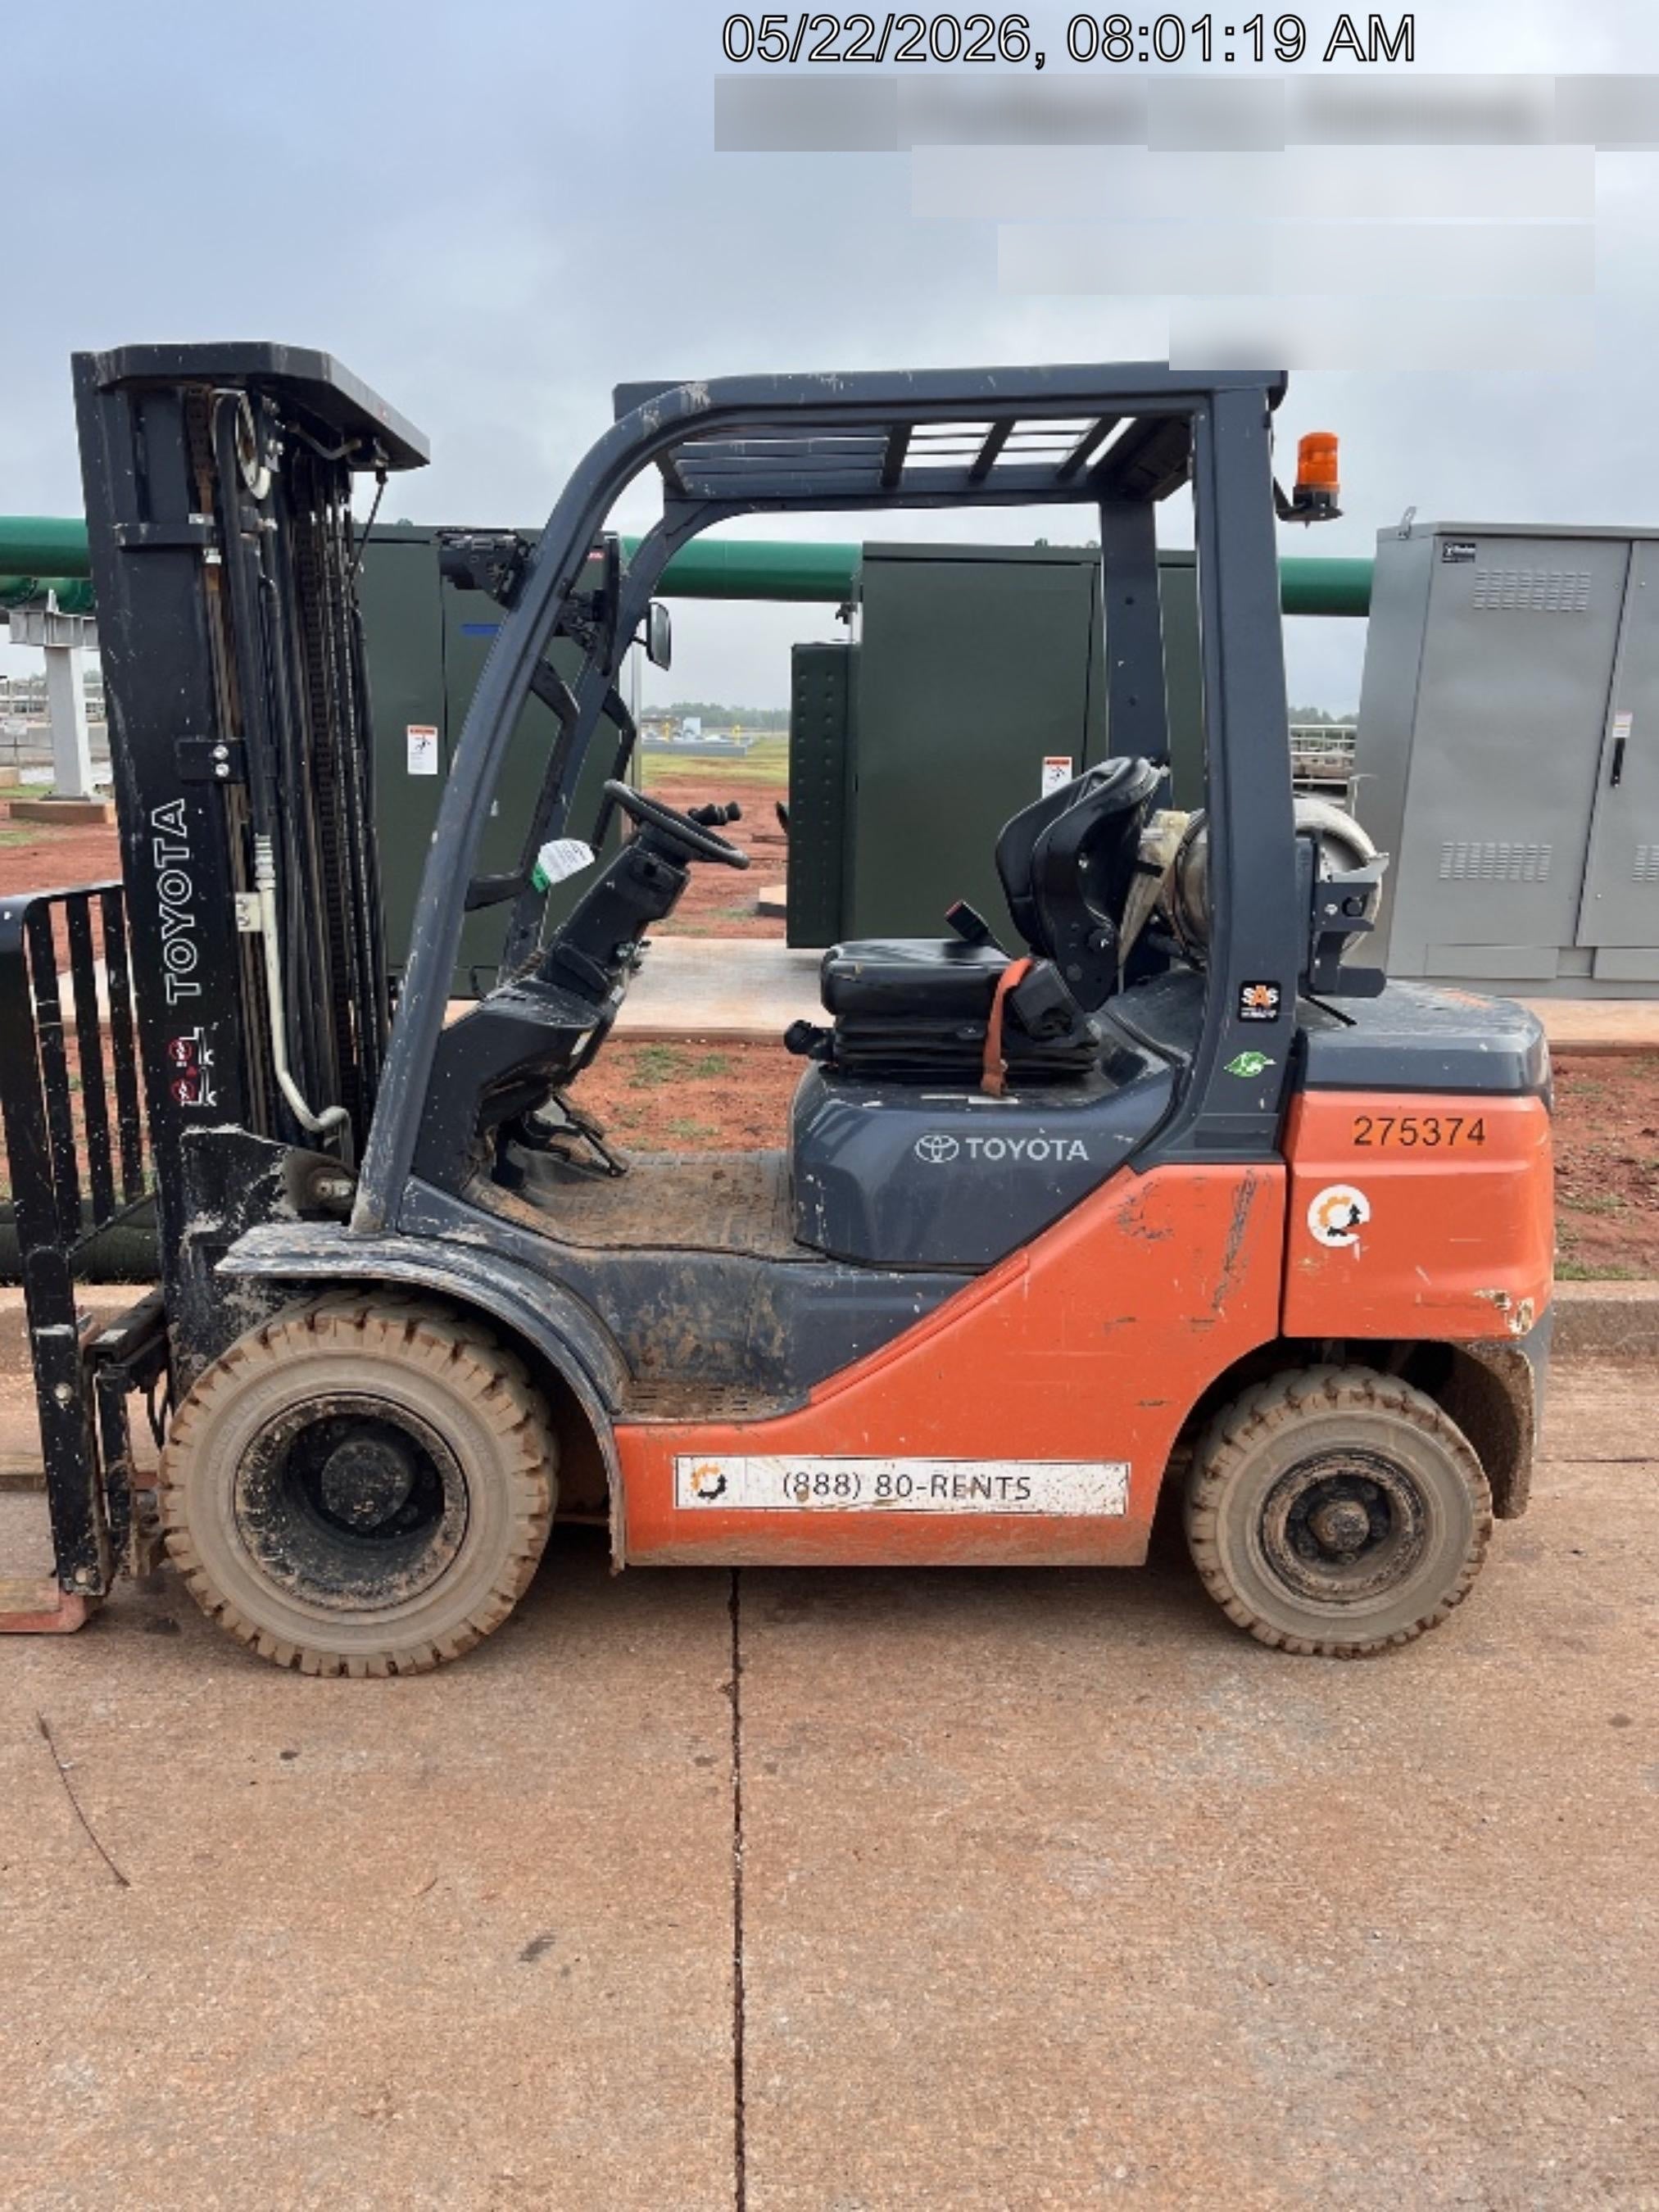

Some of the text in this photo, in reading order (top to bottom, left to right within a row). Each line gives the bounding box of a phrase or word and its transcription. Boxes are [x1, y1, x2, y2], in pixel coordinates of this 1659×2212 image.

[151, 798, 202, 1005] TOYOTA
[1353, 1117, 1485, 1146] 275374
[965, 1137, 1090, 1161] TOYOTA
[782, 1471, 1031, 1500] (888) 80-RENTS
